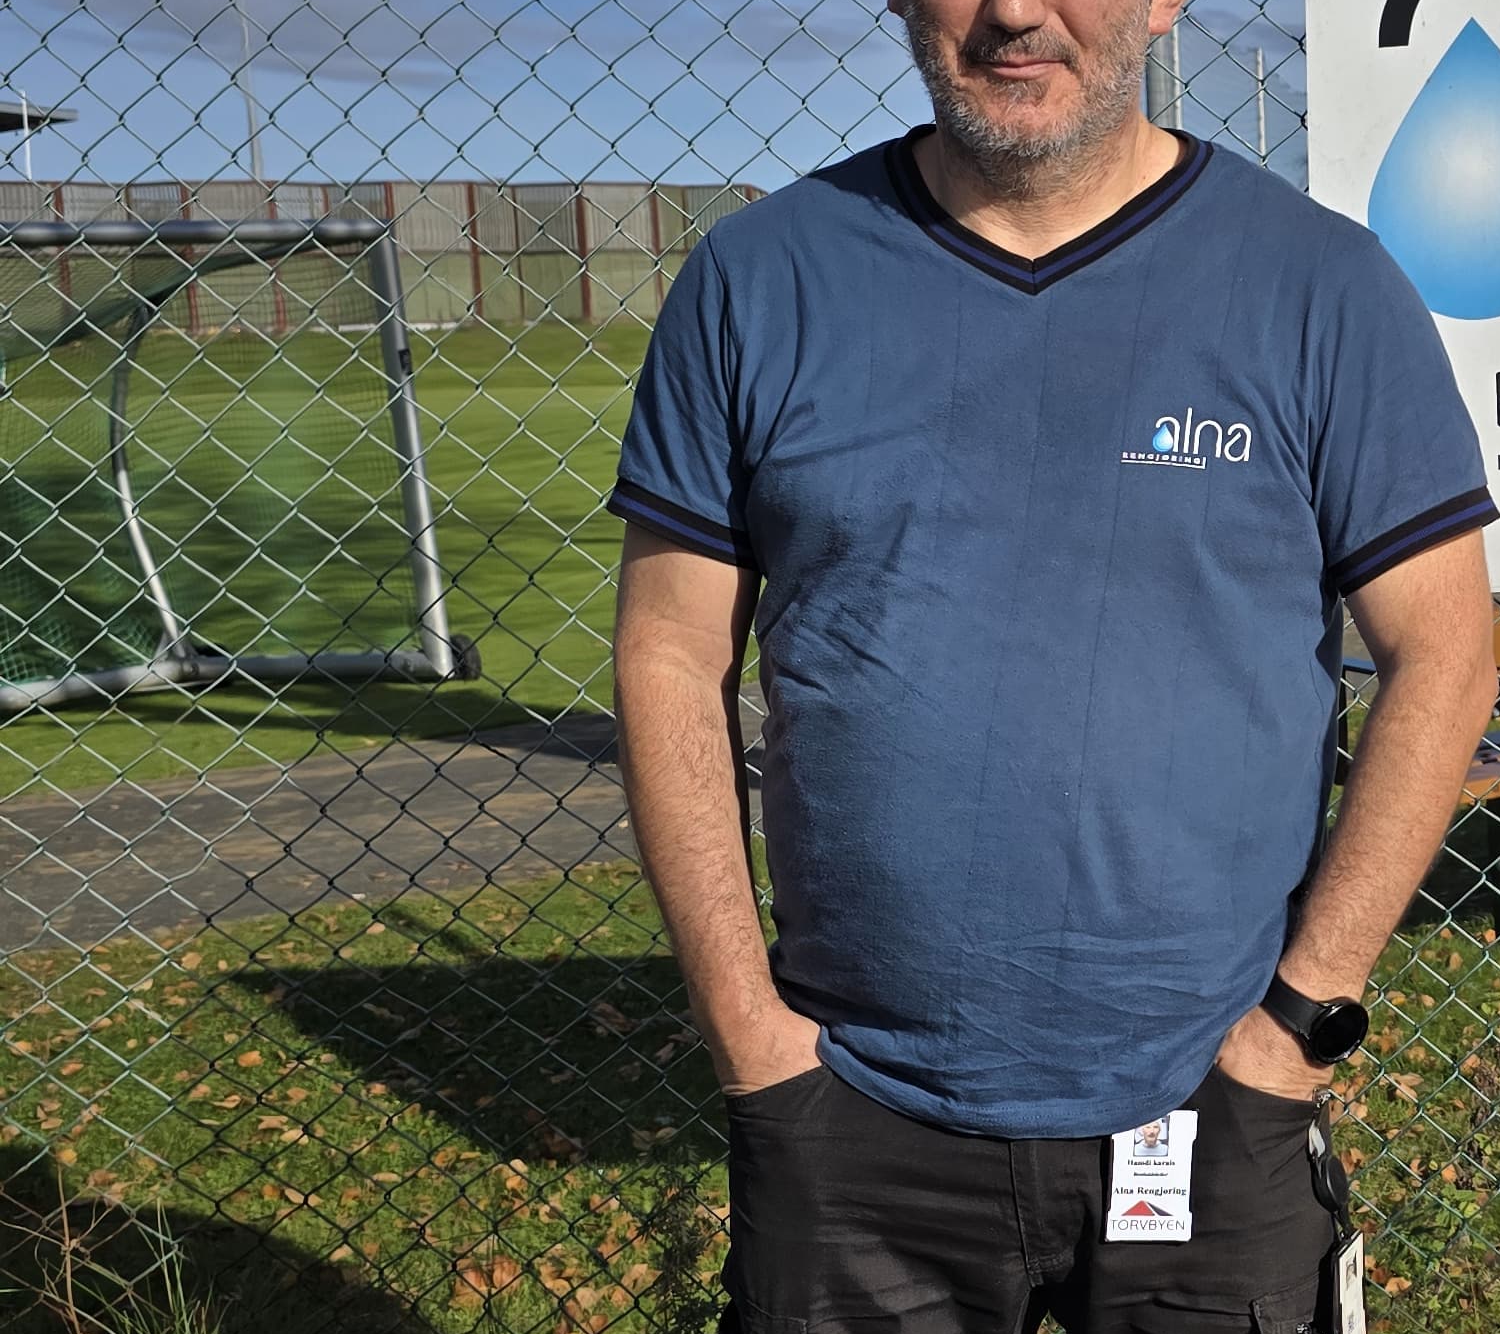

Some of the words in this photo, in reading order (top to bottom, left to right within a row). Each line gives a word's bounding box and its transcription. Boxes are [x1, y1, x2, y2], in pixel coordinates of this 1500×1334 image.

[1152, 407, 1252, 462] alna
[1114, 1186, 1134, 1195] Alna
[1111, 1219, 1185, 1231] TORVBYEN
